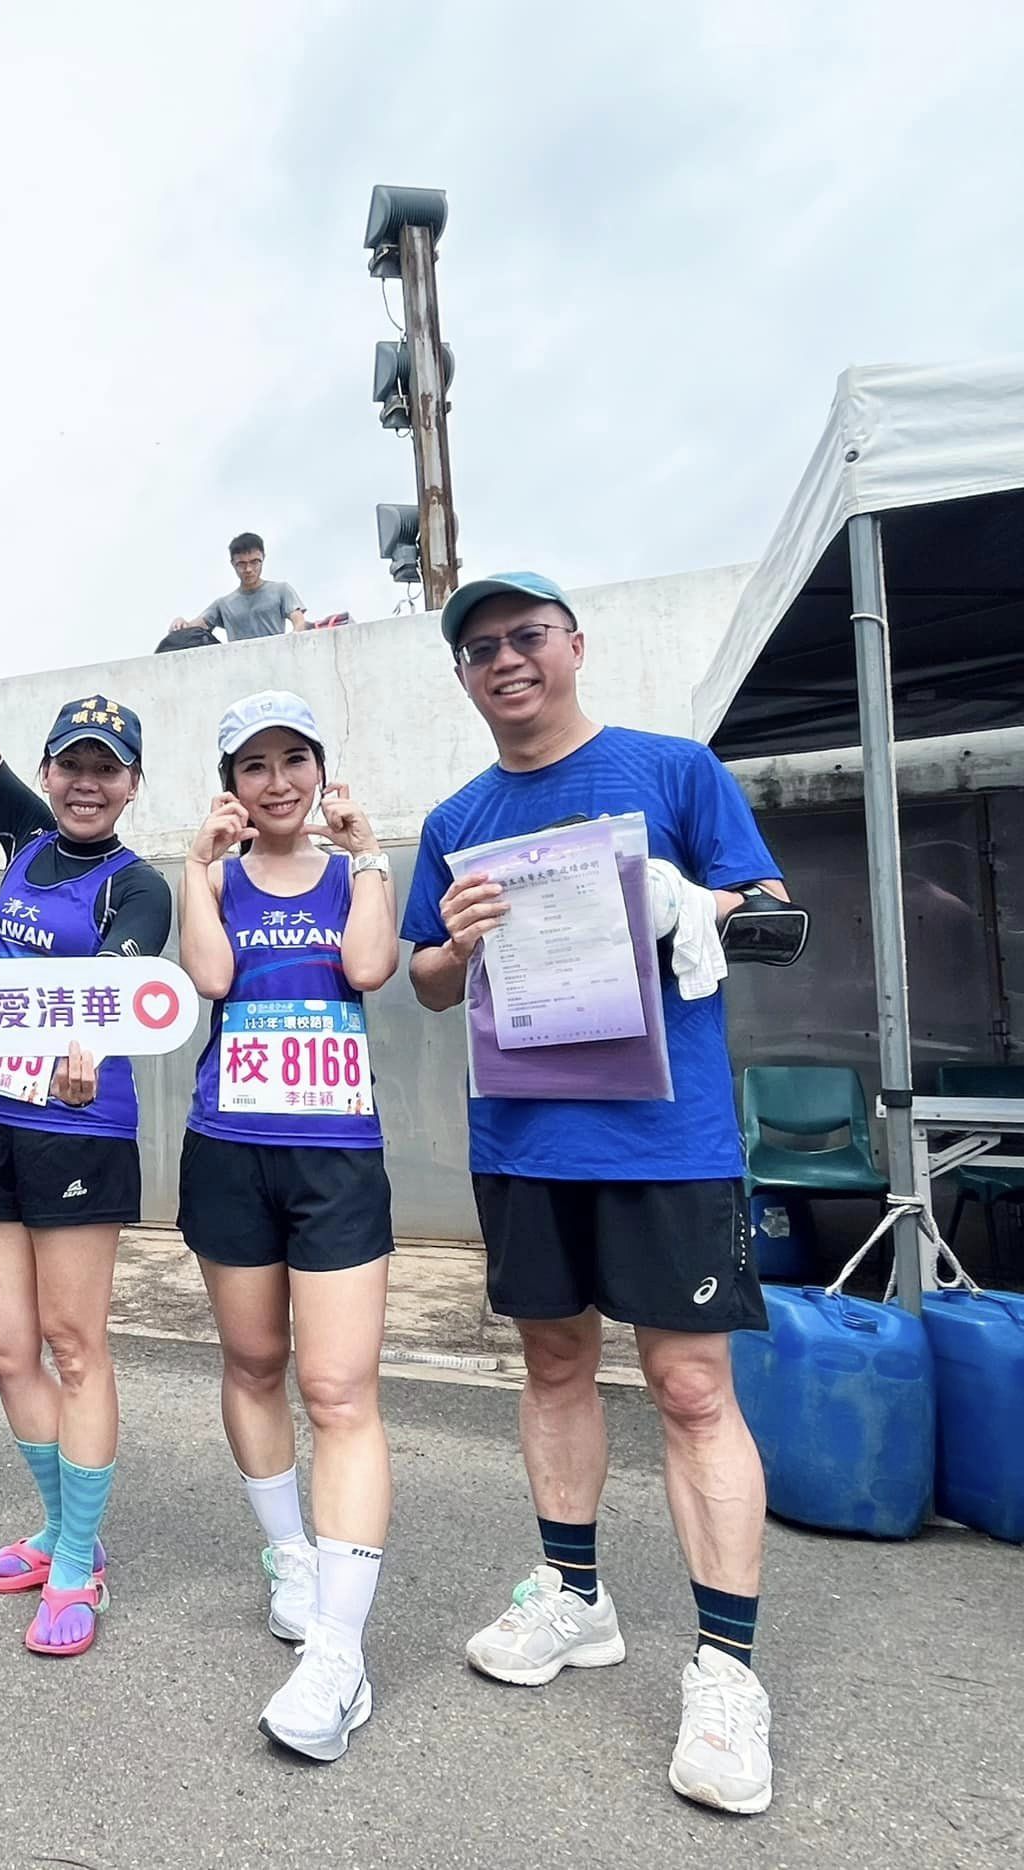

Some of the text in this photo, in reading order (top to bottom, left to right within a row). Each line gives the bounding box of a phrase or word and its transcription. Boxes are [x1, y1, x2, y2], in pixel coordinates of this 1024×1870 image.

[1, 897, 40, 921] 清大
[261, 910, 316, 926] 清大
[236, 928, 342, 947] TAIWAN
[226, 1037, 361, 1087] 校 8168
